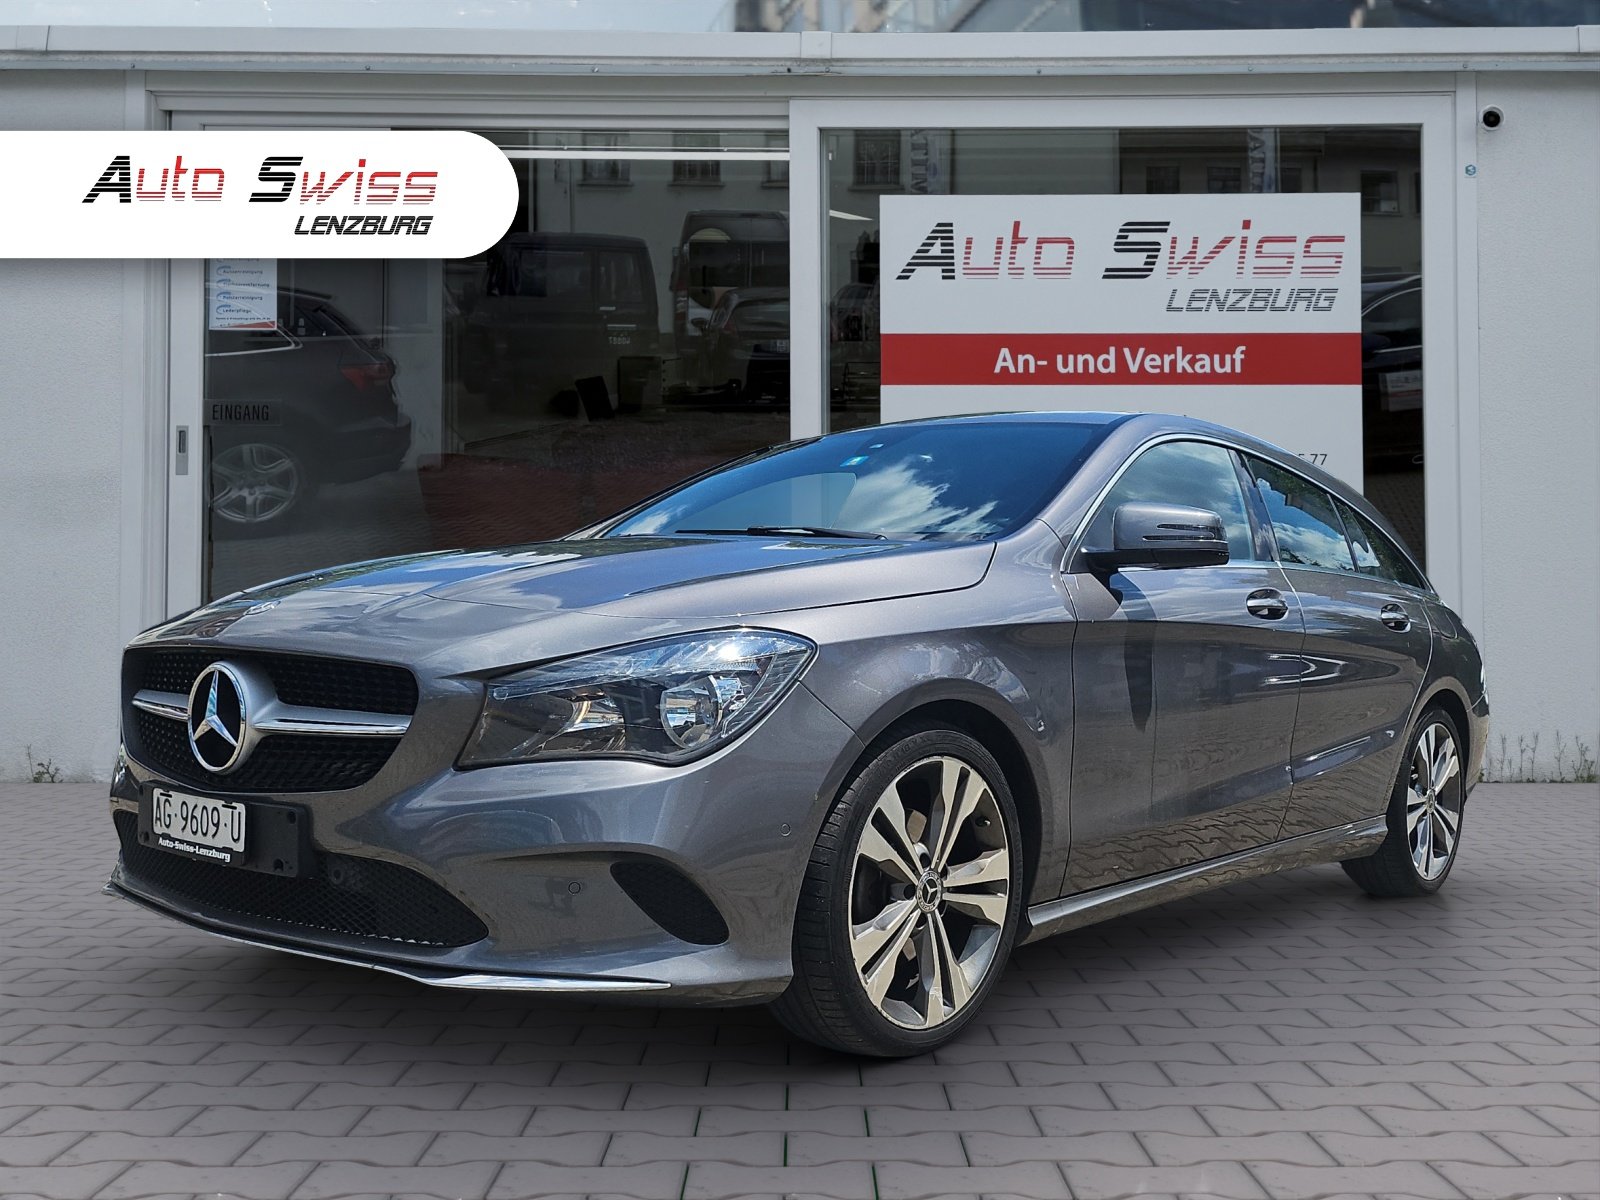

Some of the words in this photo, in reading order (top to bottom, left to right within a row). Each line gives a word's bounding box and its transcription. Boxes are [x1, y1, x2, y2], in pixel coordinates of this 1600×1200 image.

[895, 220, 1075, 281] Auto
[1101, 219, 1346, 280] Swiss
[1165, 288, 1339, 312] LENZBURG
[993, 347, 1048, 374] An-
[1056, 346, 1117, 374] und
[1123, 345, 1246, 374] Verkauf
[212, 404, 269, 421] EINGANG
[157, 836, 232, 863] Auto-Swiss-Lenzburg
